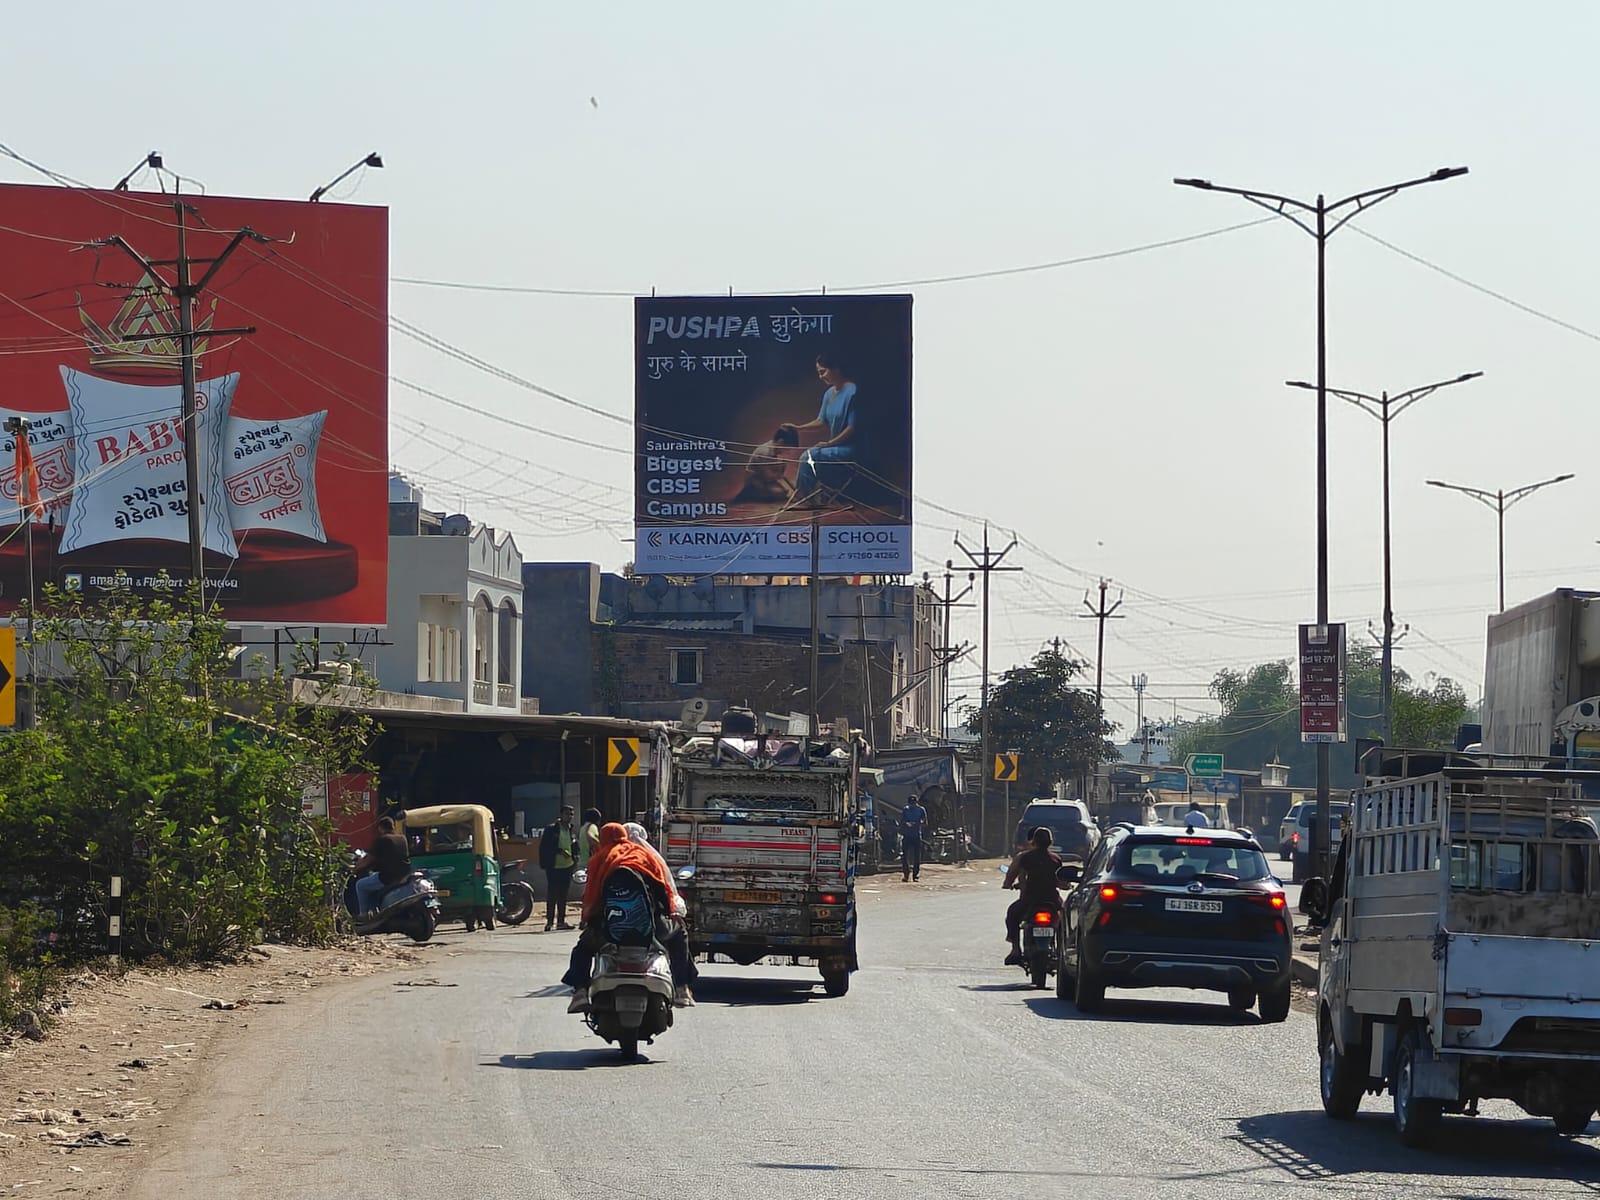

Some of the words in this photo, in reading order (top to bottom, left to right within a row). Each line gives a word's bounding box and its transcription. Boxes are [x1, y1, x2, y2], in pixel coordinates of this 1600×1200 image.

[647, 316, 760, 344] PUSHPA
[769, 306, 833, 343] झुकेगा
[648, 356, 674, 380] गुरु
[680, 350, 697, 372] के
[702, 349, 749, 373] सामने
[646, 440, 726, 451] Saurashtra's
[647, 455, 722, 475] Biggest
[647, 478, 700, 494] CBSE
[646, 500, 727, 518] Campus
[669, 532, 768, 545] KARNAVATI
[776, 532, 812, 545] CBS
[828, 531, 899, 545] SCHOOL
